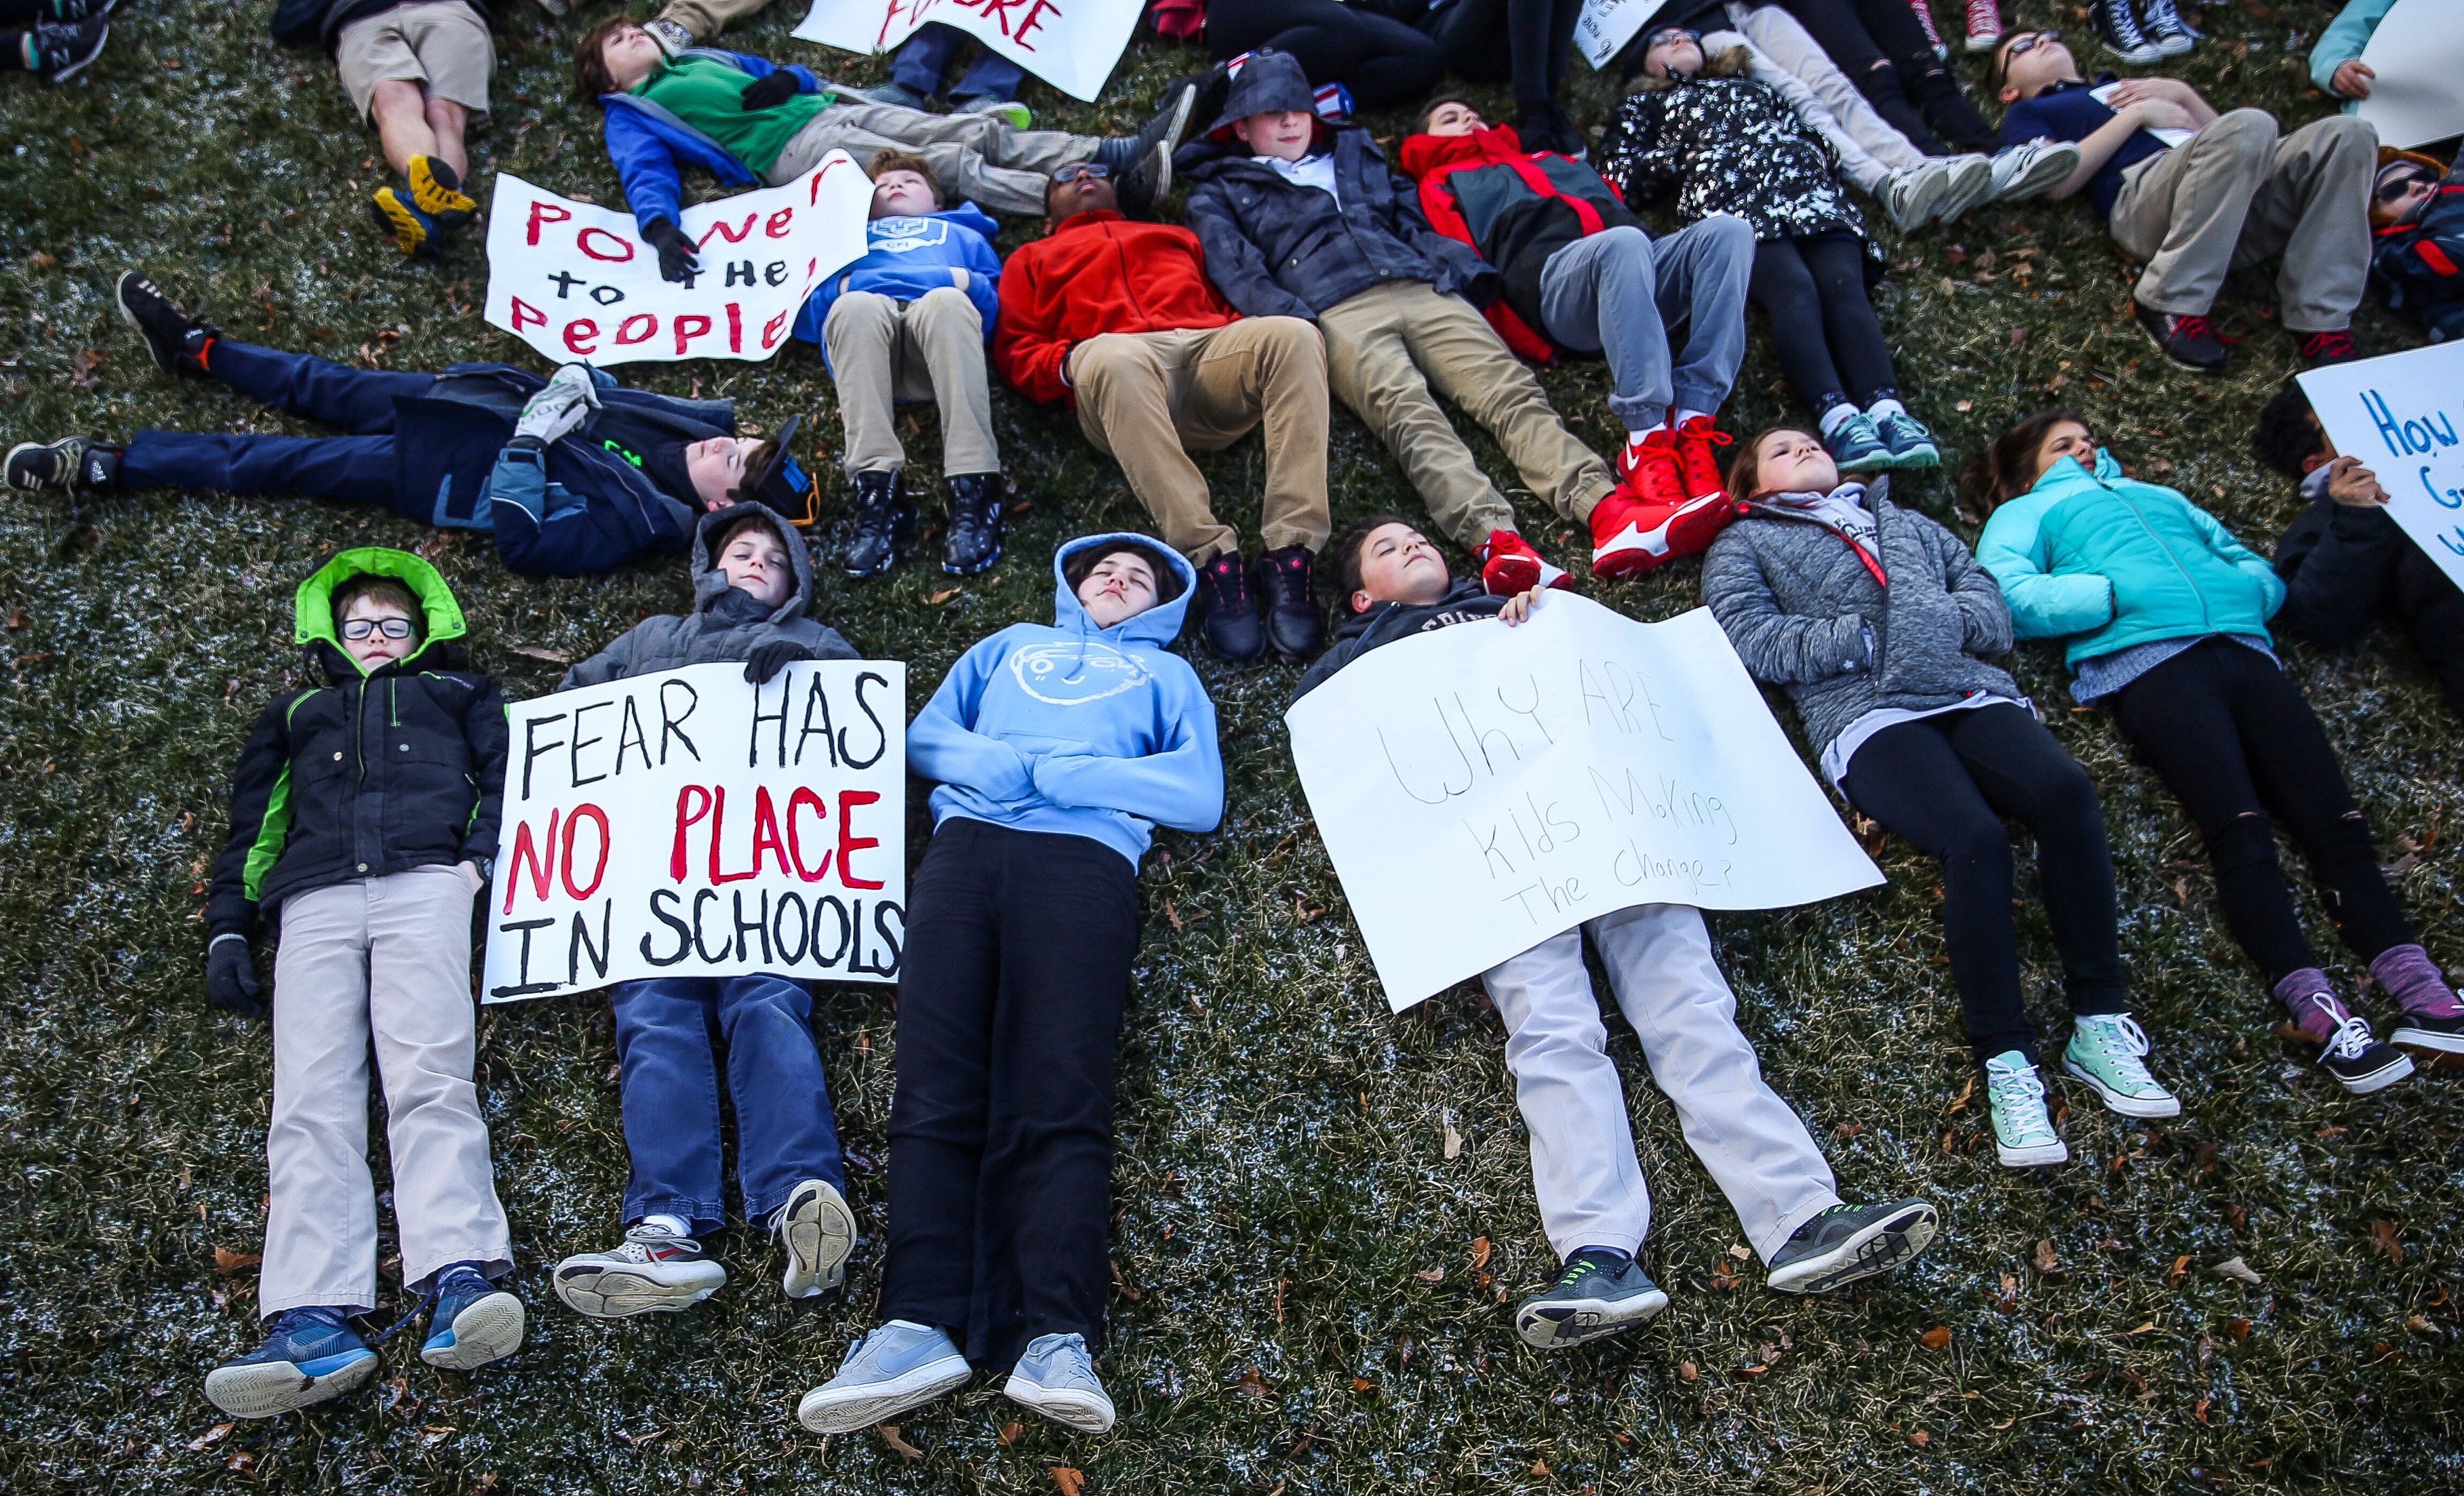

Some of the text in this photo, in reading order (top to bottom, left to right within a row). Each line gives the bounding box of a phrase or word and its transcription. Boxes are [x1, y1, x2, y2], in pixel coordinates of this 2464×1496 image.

[547, 270, 625, 306] to
[521, 669, 889, 801] FEAR HAS
[1579, 658, 1675, 742] ARE
[1587, 765, 1737, 845] Making
[502, 784, 885, 916] NO PLACE
[1501, 838, 1732, 925] The Change?
[490, 887, 906, 998] IN SCHOOLS
